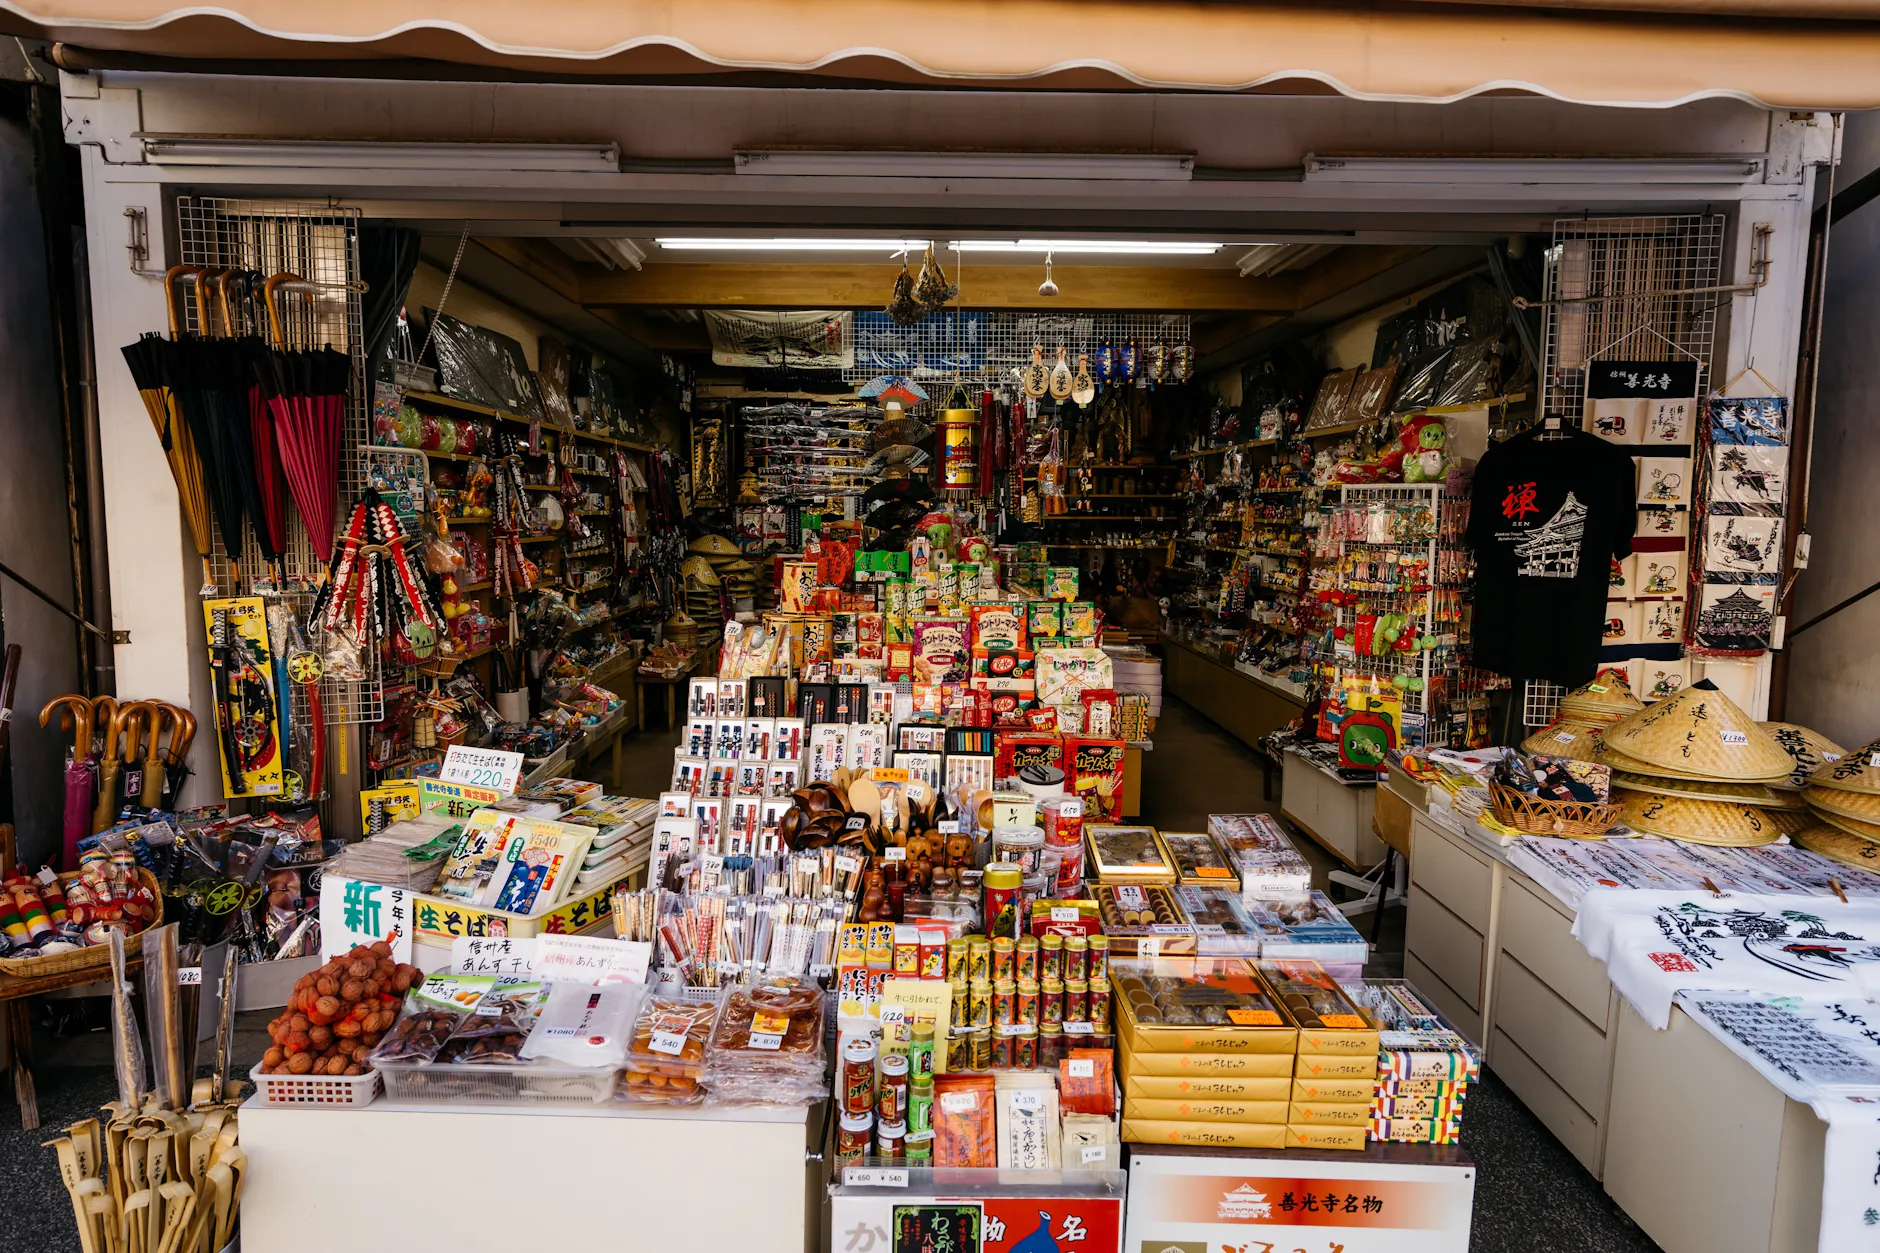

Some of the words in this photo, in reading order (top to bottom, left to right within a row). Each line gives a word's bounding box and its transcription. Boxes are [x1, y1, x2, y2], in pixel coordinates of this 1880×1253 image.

[1610, 370, 1626, 378] 信州
[1624, 373, 1672, 390] 善光寺
[1720, 406, 1781, 431] 善光寺
[977, 618, 1021, 632] カントリーマアム
[921, 635, 964, 647] カントリーマアム
[994, 657, 1012, 670] KitKat
[1053, 659, 1097, 672] じゃがりこ
[995, 697, 1012, 709] KitKat
[1075, 752, 1117, 771] カラムーチョ
[470, 768, 503, 787] 220
[503, 778, 512, 788] 円
[464, 788, 497, 803] 限定販売
[529, 833, 559, 848] ¥540
[391, 889, 404, 938] 今年も
[852, 926, 866, 941] ゆず
[878, 924, 892, 940] ゆず
[469, 940, 512, 955] 信州産
[660, 972, 674, 982] 320
[852, 969, 867, 1002] にんにく
[661, 1038, 679, 1049] 540
[763, 1038, 780, 1046] 870
[1022, 1096, 1036, 1104] 370
[1278, 1192, 1384, 1214] 善光寺名物
[982, 1214, 1007, 1242] 物
[1056, 1214, 1088, 1242] 名
